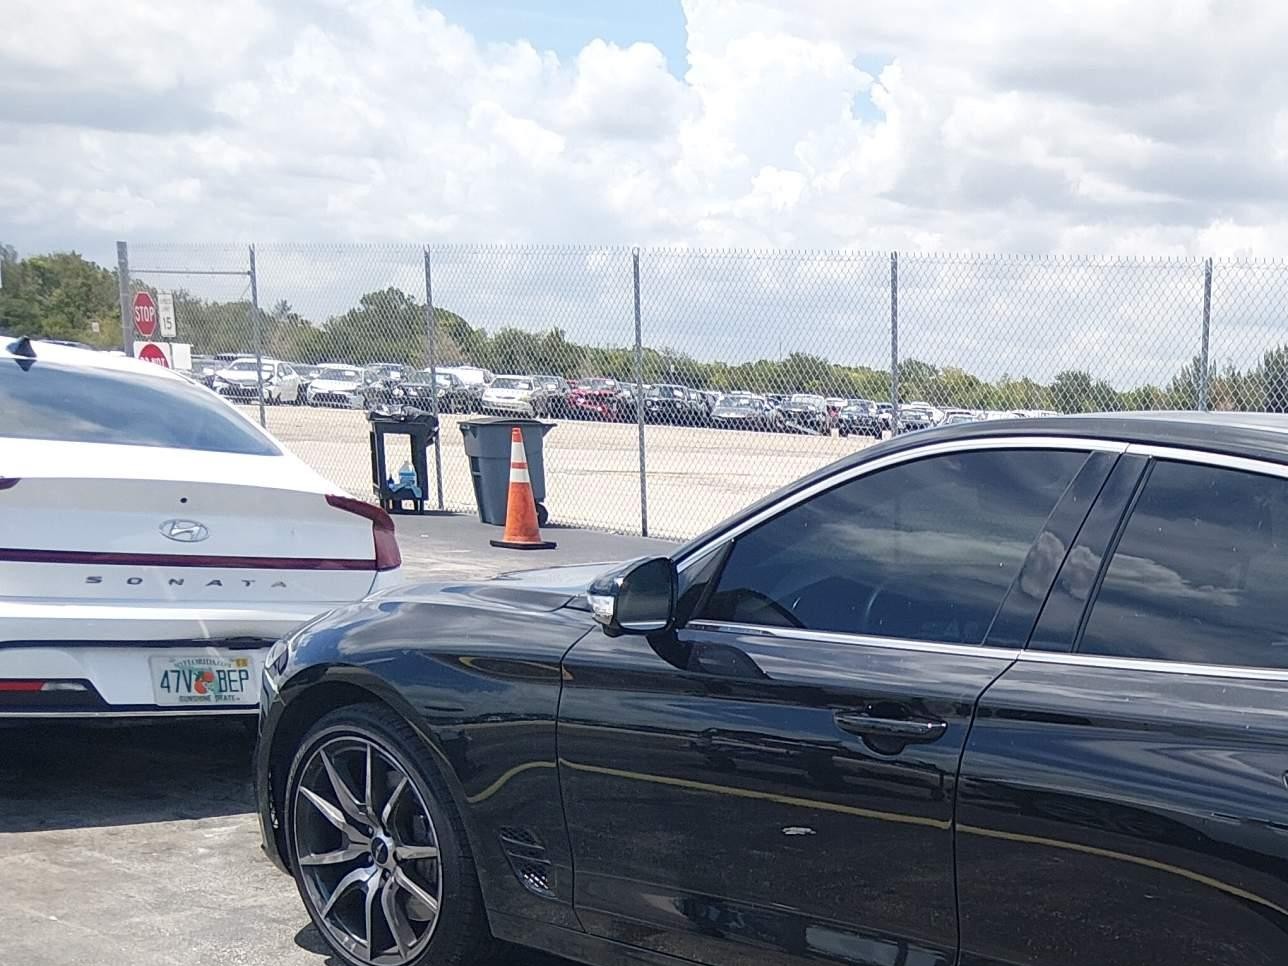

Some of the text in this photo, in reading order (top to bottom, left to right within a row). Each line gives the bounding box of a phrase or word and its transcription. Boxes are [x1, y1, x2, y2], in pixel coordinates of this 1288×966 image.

[135, 306, 155, 322] STOP
[163, 316, 173, 330] 15
[85, 576, 287, 588] SONATA
[160, 669, 249, 693] 47V BEP
